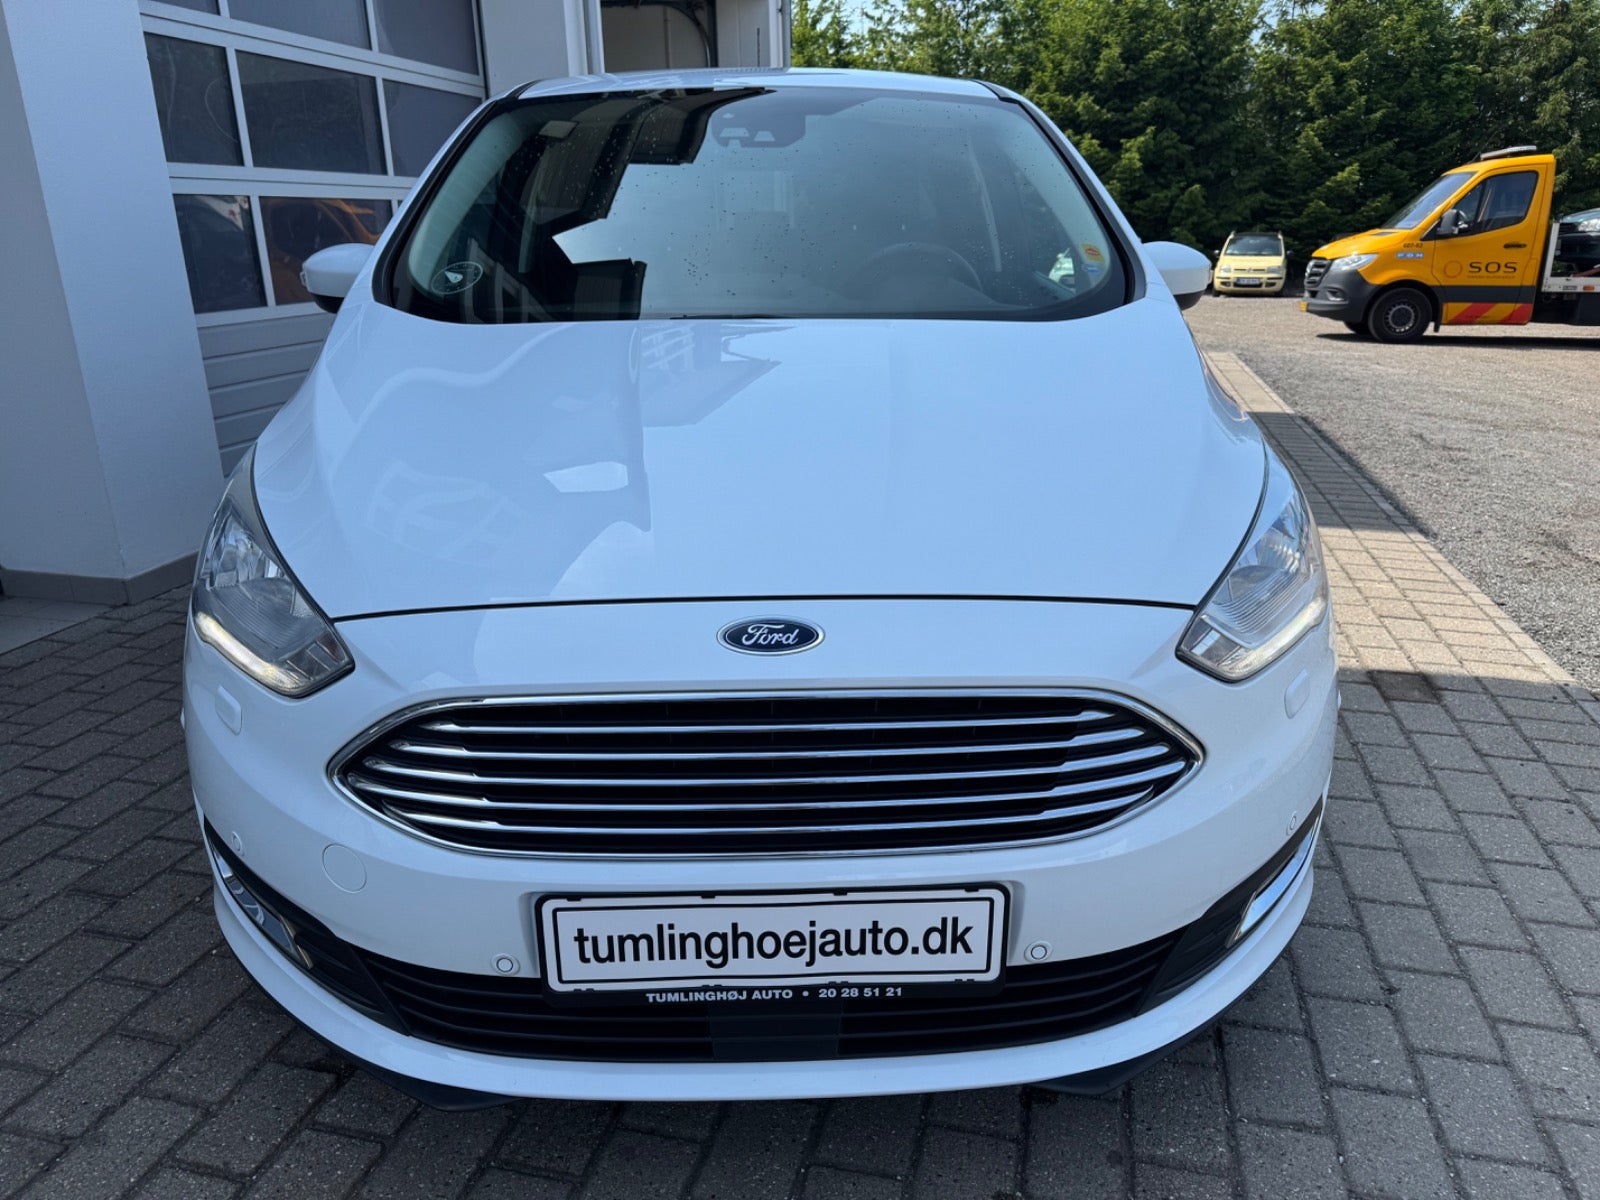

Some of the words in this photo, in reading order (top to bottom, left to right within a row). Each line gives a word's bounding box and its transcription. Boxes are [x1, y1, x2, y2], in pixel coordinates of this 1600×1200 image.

[1468, 261, 1517, 274] SOS
[741, 623, 800, 646] Ford
[573, 916, 975, 969] tumlinghoejauto.dk
[645, 990, 748, 1003] TUMLINGHØJ
[751, 989, 794, 1001] AUTO
[818, 988, 837, 998] 20
[840, 987, 860, 998] 28
[863, 986, 881, 997] 51
[885, 986, 903, 997] 21
